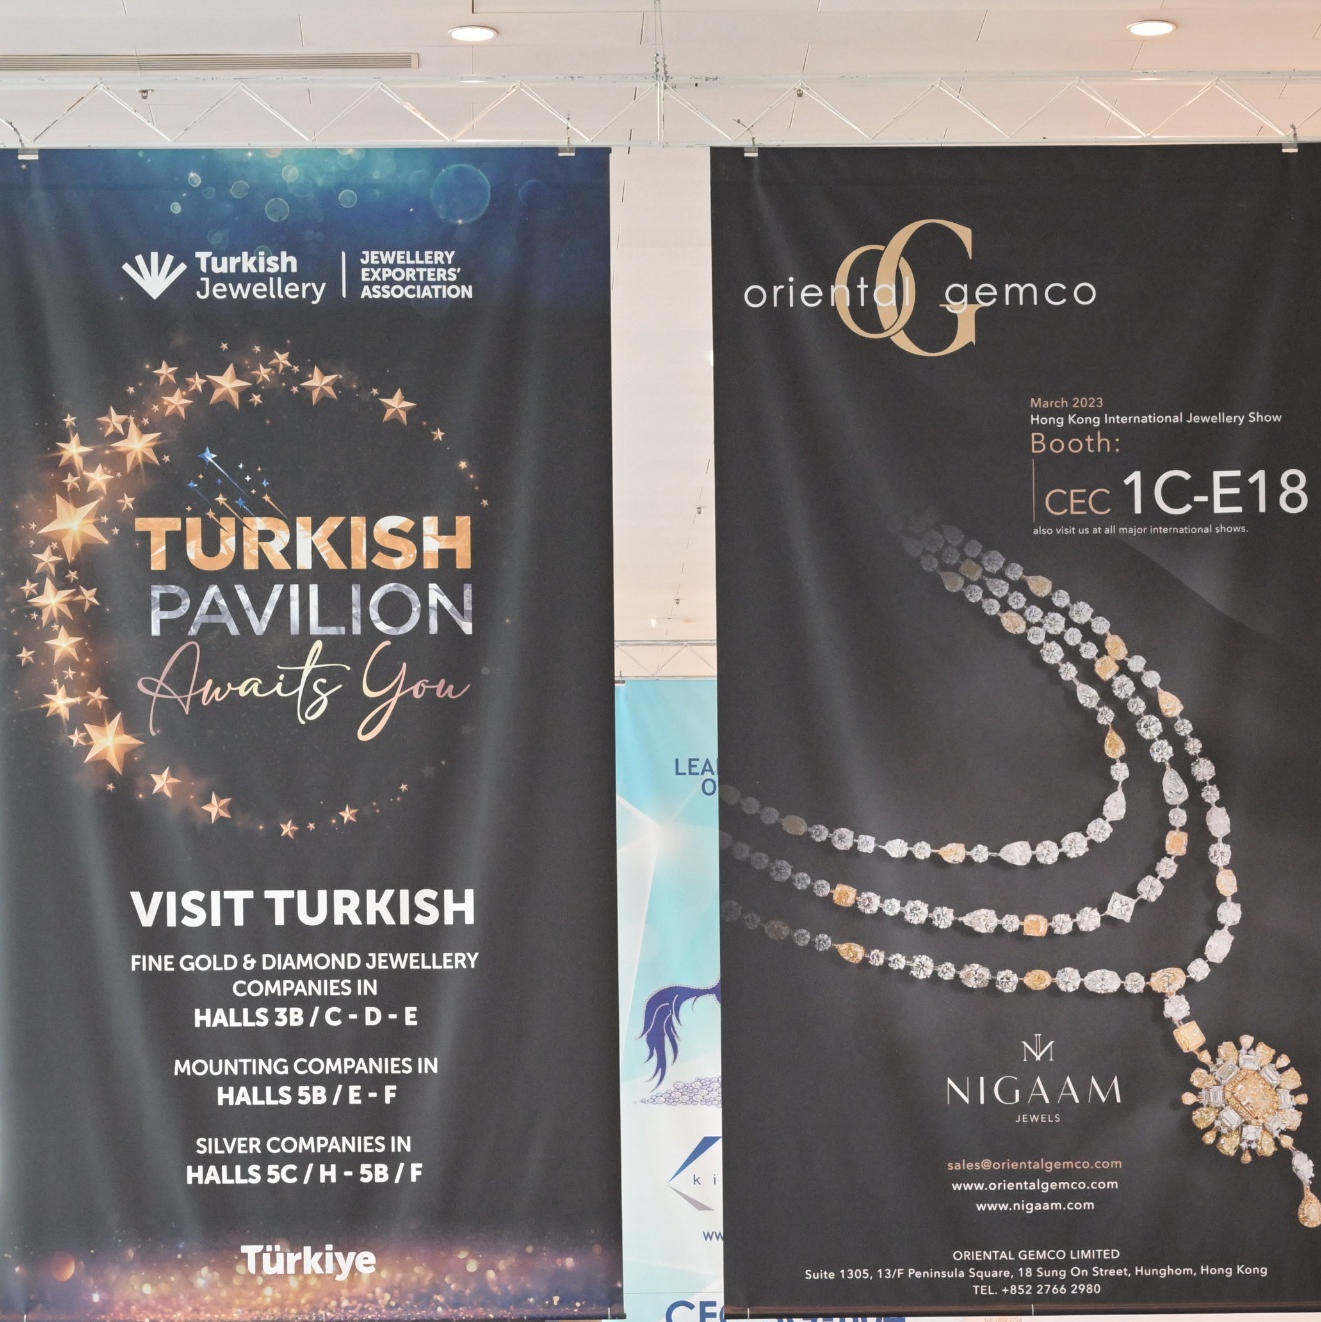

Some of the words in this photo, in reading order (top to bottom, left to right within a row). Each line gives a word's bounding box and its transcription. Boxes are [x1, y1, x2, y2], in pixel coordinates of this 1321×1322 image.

[194, 250, 298, 274] Turkish
[359, 250, 456, 265] JEWELLERY
[361, 267, 461, 282] EXPORTERS'
[195, 276, 327, 305] Jewellery
[360, 284, 473, 299] ASSOCIATION
[744, 275, 910, 308] oriental
[945, 282, 1096, 315] gemco
[1030, 396, 1069, 409] March
[1072, 396, 1104, 408] 2023
[1030, 413, 1065, 428] Hong
[1068, 413, 1101, 428] Kong
[1104, 411, 1183, 424] International
[1186, 411, 1245, 426] Jewellery
[1248, 411, 1283, 423] Show
[1031, 430, 1120, 454] Booth:
[1044, 488, 1112, 516] CEC
[1123, 468, 1309, 516] 1C-E18
[134, 513, 472, 571] TURKISH
[150, 582, 473, 637] PAVILION
[136, 640, 350, 736] Awaits
[356, 640, 472, 742] You
[674, 757, 719, 776] LEA
[129, 889, 255, 928] VISIT
[263, 888, 475, 927] TURKISH
[131, 954, 175, 972] FINE
[179, 953, 238, 972] GOLD
[261, 952, 362, 971] DIAMOND
[365, 951, 480, 970] JEWELLERY
[232, 978, 352, 998] COMPANIES
[357, 978, 378, 996] IN
[194, 1006, 270, 1028] HALLS
[274, 1006, 305, 1027] 3B
[946, 1075, 1122, 1105] NIGAAM
[1015, 1113, 1061, 1123] JEWELS
[947, 1157, 1123, 1173] sales@orientalgemco.com
[951, 1178, 1119, 1194] www.orientalgemco.com
[975, 1199, 1095, 1214] www.nigaam.com
[240, 1244, 377, 1281] Türkiye
[952, 1250, 1016, 1261] ORIENTAL
[1017, 1249, 1067, 1261] GEMCO
[1070, 1248, 1121, 1260] LIMITED
[804, 1269, 836, 1280] Suite
[839, 1268, 873, 1281] 1305,
[877, 1268, 905, 1279] 13/F
[908, 1267, 965, 1279] Peninsula
[968, 1267, 1014, 1281] Square,
[1018, 1266, 1033, 1278] 18
[1036, 1266, 1067, 1280] Sung
[1070, 1266, 1089, 1277] On
[1091, 1266, 1132, 1278] Street,
[1134, 1264, 1197, 1279] Hunghom,
[1200, 1264, 1233, 1278] Hong
[1236, 1264, 1268, 1278] Kong
